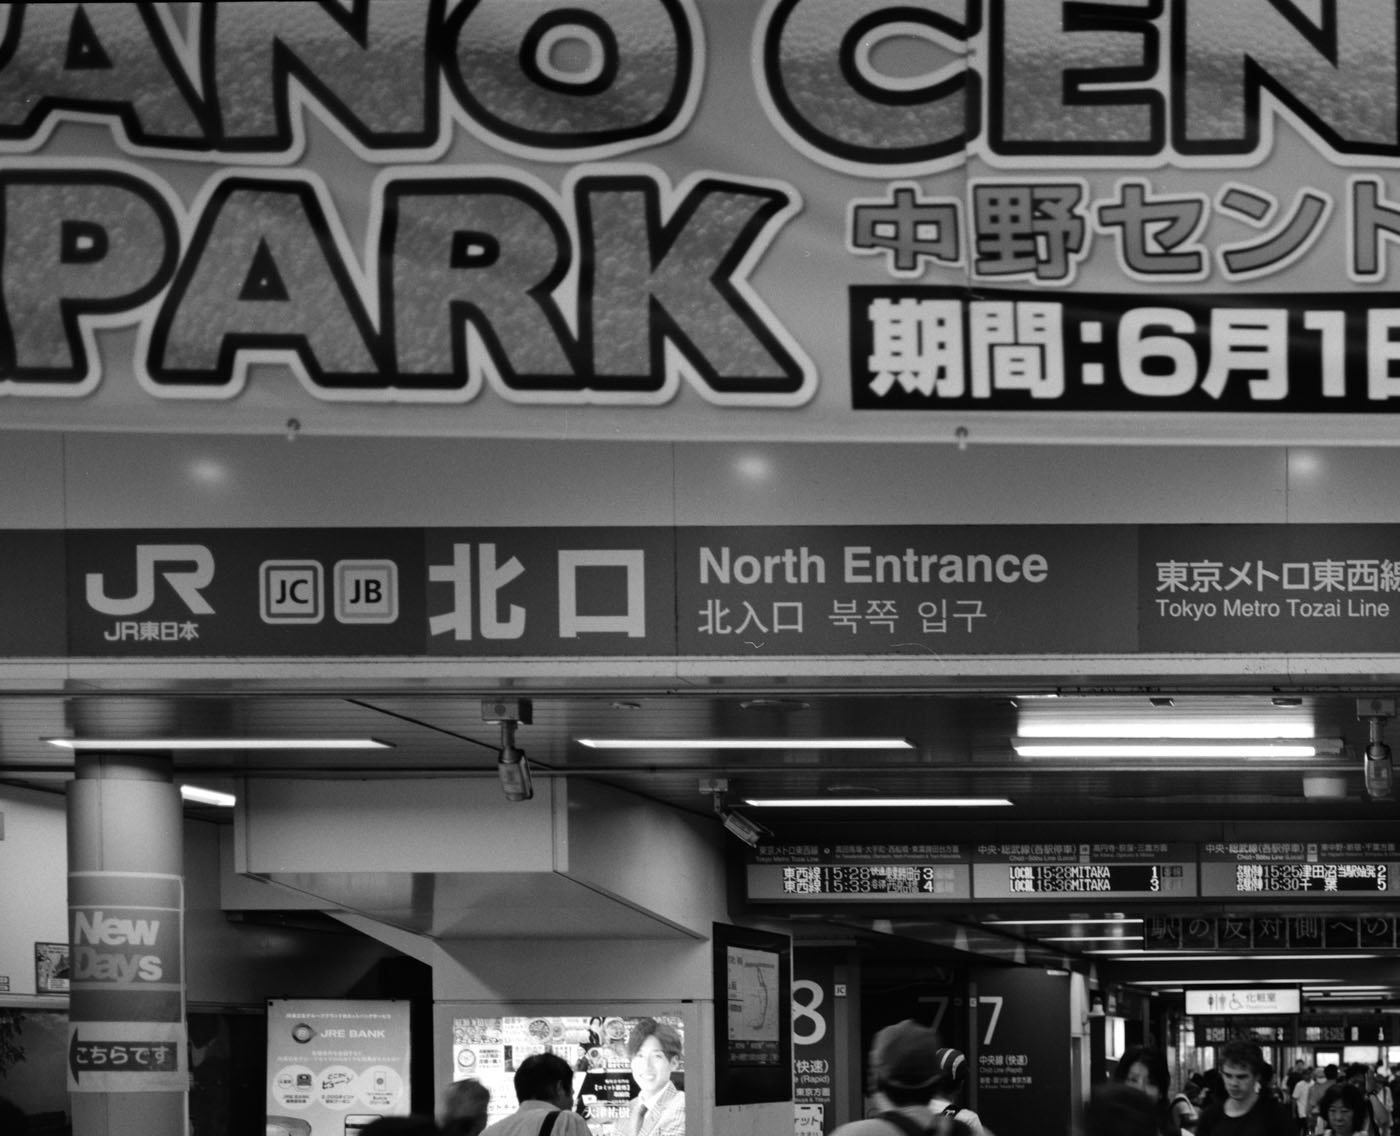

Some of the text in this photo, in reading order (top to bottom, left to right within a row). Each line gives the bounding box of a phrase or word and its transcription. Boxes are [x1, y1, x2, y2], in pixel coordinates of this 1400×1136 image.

[0, 168, 808, 397] PARK
[700, 547, 1048, 583] North Entrance
[86, 544, 216, 615] JR
[275, 579, 310, 605] JC
[350, 579, 383, 604] JB
[428, 543, 645, 640] 北口
[698, 599, 803, 635] 北入口
[828, 599, 987, 634] 북쪽 입구
[1157, 599, 1390, 621] Tokyo Metro Tozai Line
[104, 621, 199, 641] JR東日本
[783, 866, 822, 880] 東西線
[825, 867, 870, 880] 15:28
[923, 867, 934, 880] 3
[1037, 866, 1071, 879] 15:28
[1070, 865, 1110, 879] MITAKA
[1151, 865, 1158, 878] 1
[1264, 865, 1299, 878] 15:25
[1377, 864, 1387, 878] 2
[783, 880, 822, 893] 東西線
[825, 880, 870, 892] 15:33
[923, 880, 934, 893] 4
[1037, 879, 1071, 891] 15:36
[1070, 878, 1110, 892] MITAKA
[1150, 879, 1159, 892] 3
[1264, 878, 1299, 891] 15:30
[1377, 878, 1387, 891] 5
[73, 911, 161, 946] New
[73, 951, 163, 983] Days
[793, 979, 828, 1044] 8
[979, 996, 1004, 1045] 7
[320, 1029, 387, 1039] JRE BANK
[75, 1044, 171, 1066] こちらです
